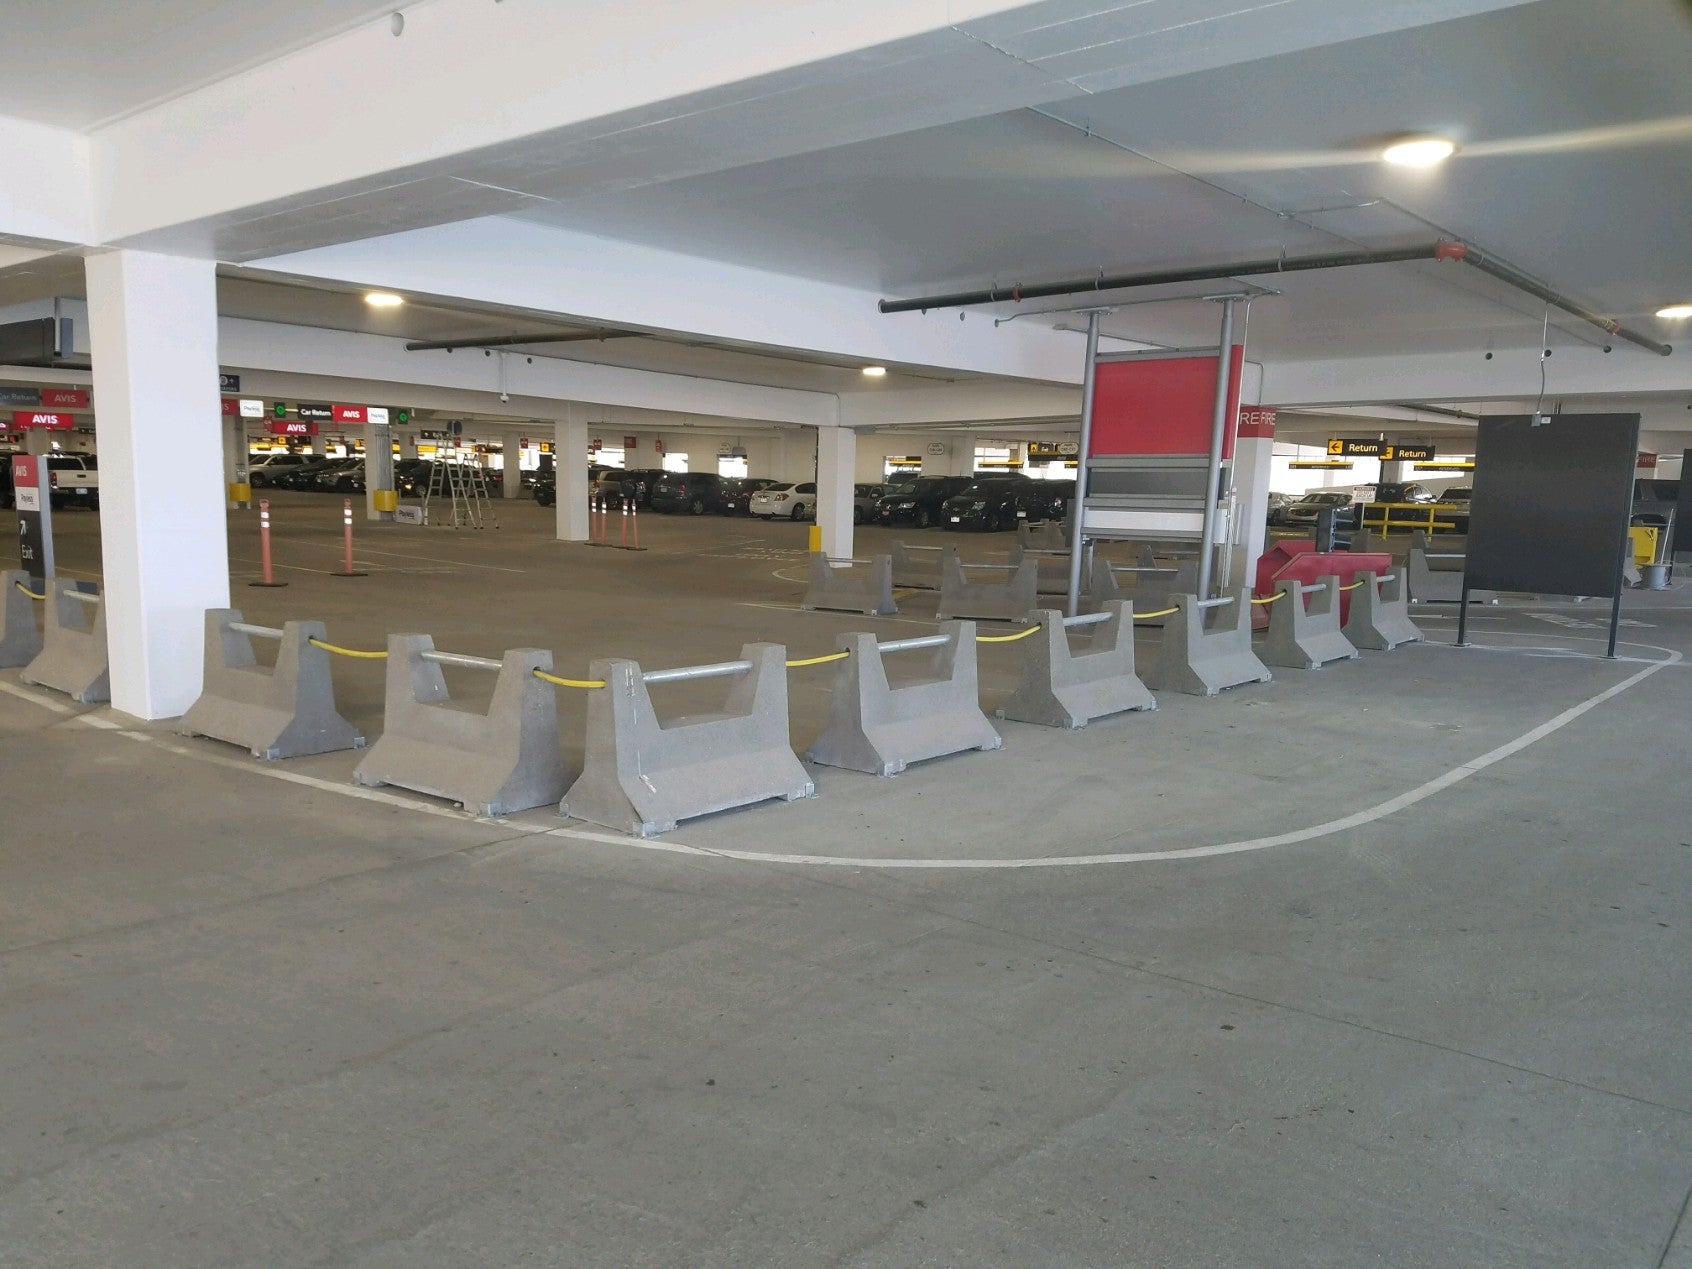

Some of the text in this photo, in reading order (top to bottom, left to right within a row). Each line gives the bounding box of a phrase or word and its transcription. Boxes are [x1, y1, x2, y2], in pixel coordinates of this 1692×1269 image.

[54, 394, 77, 402] AVIS
[32, 414, 58, 424] AVIS
[342, 410, 360, 419] AVIS
[1240, 412, 1259, 425] RE
[1260, 412, 1276, 425] FIRE
[286, 423, 307, 432] AVIS
[1348, 443, 1378, 452] Return
[1398, 450, 1427, 458] Return
[15, 465, 28, 477] AVIS
[22, 545, 34, 559] Exit
